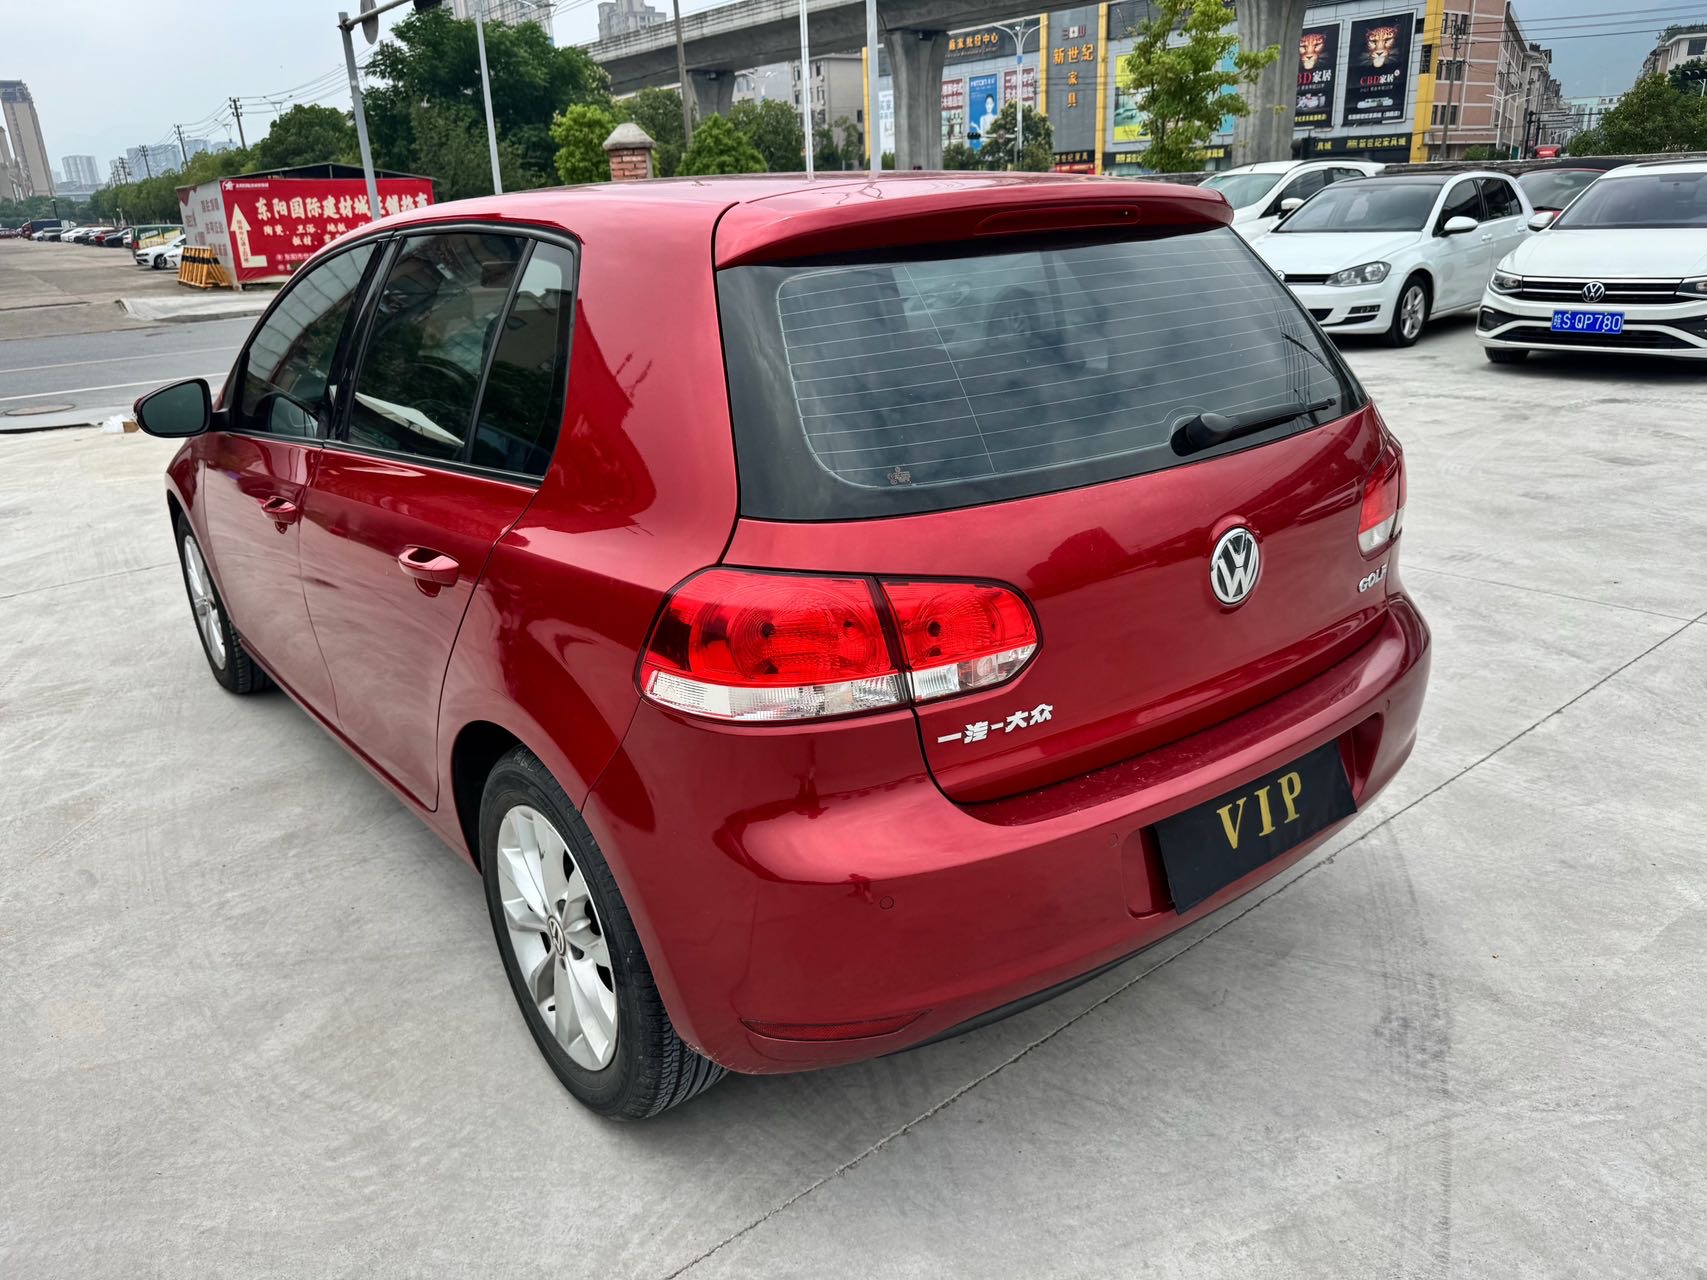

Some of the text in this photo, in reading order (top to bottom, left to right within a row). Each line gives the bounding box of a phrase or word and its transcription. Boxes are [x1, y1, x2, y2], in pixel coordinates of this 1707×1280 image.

[1053, 43, 1094, 65] 新世纪
[1358, 563, 1387, 593] GOLF
[937, 703, 1053, 744] 一汽-大众
[1216, 771, 1302, 850] VIP
